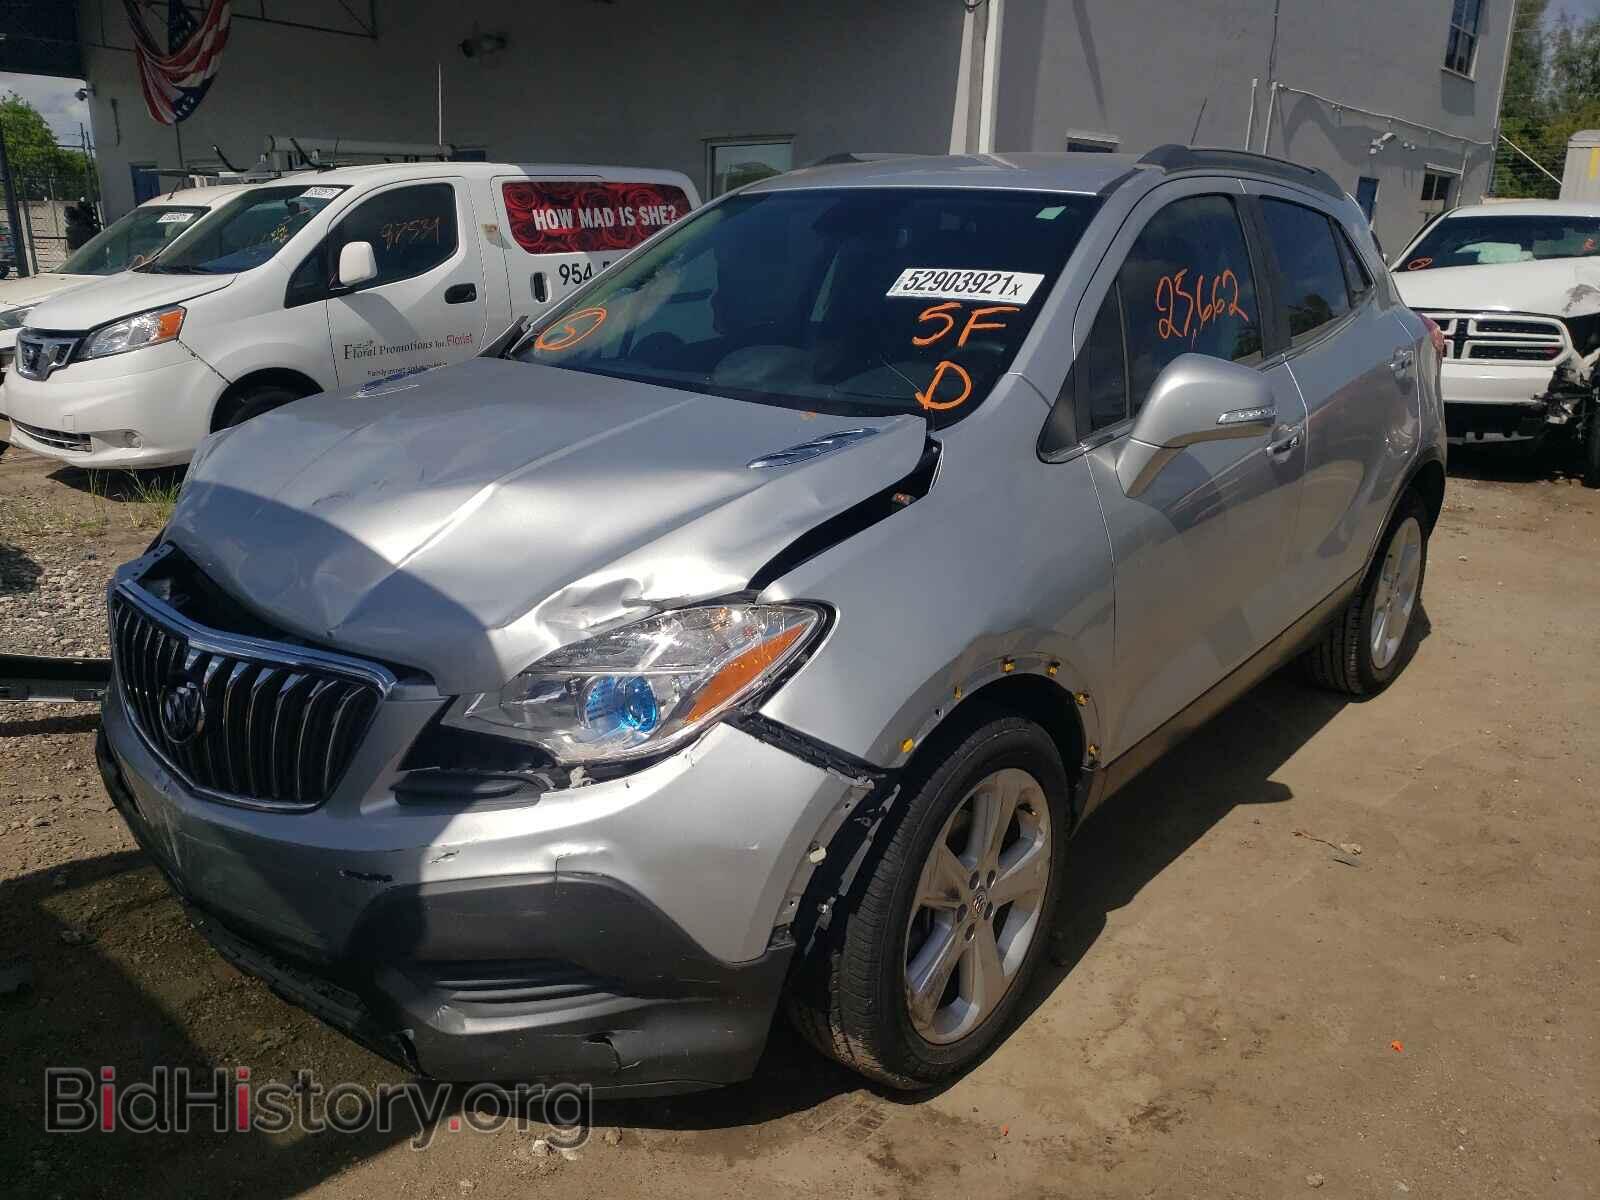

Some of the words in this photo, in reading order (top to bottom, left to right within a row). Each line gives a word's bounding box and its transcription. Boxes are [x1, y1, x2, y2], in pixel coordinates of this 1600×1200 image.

[532, 208, 574, 231] HOW
[577, 206, 615, 229] MAD
[618, 205, 636, 227] IS
[638, 204, 677, 226] SHE?
[379, 340, 433, 355] Promotions
